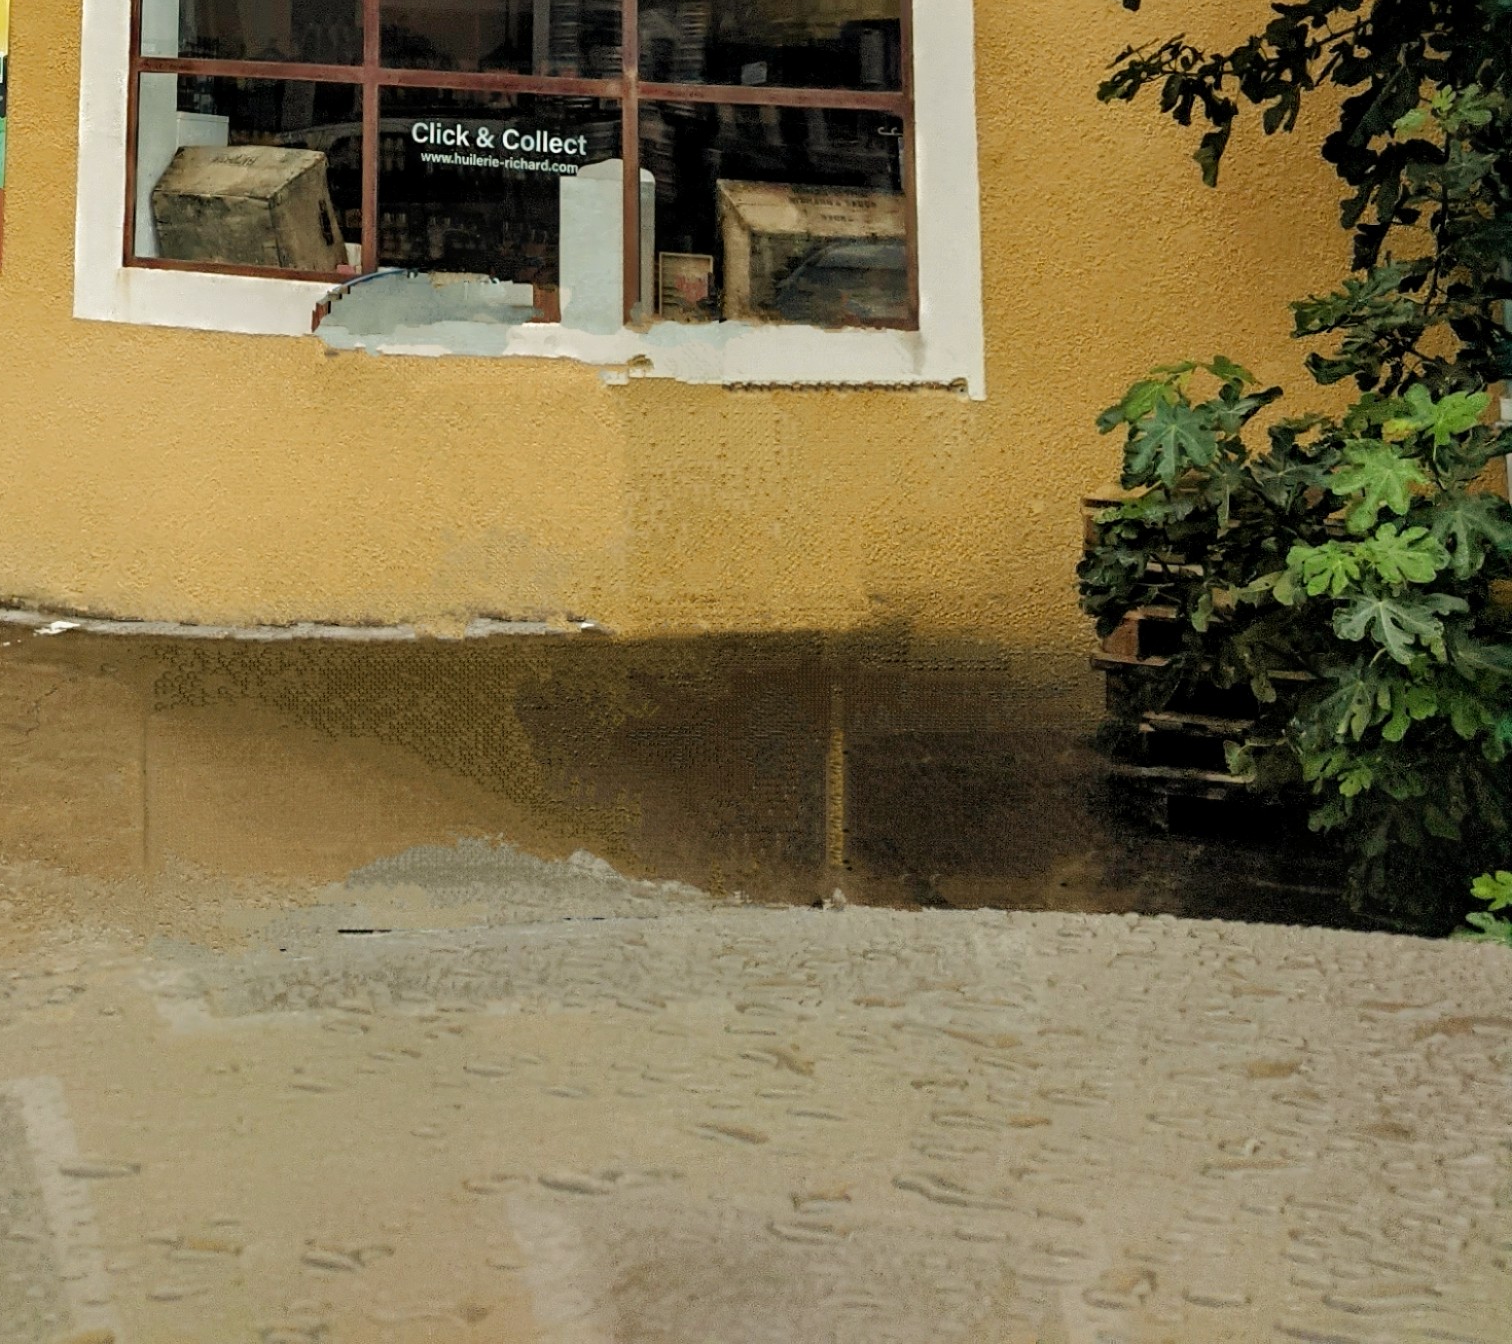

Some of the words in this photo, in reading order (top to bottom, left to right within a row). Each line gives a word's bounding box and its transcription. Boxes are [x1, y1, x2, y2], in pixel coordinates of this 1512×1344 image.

[411, 122, 470, 147] Click
[475, 126, 495, 149] &
[502, 128, 588, 156] Collect
[420, 152, 579, 175] www.huilerie-richard.com
